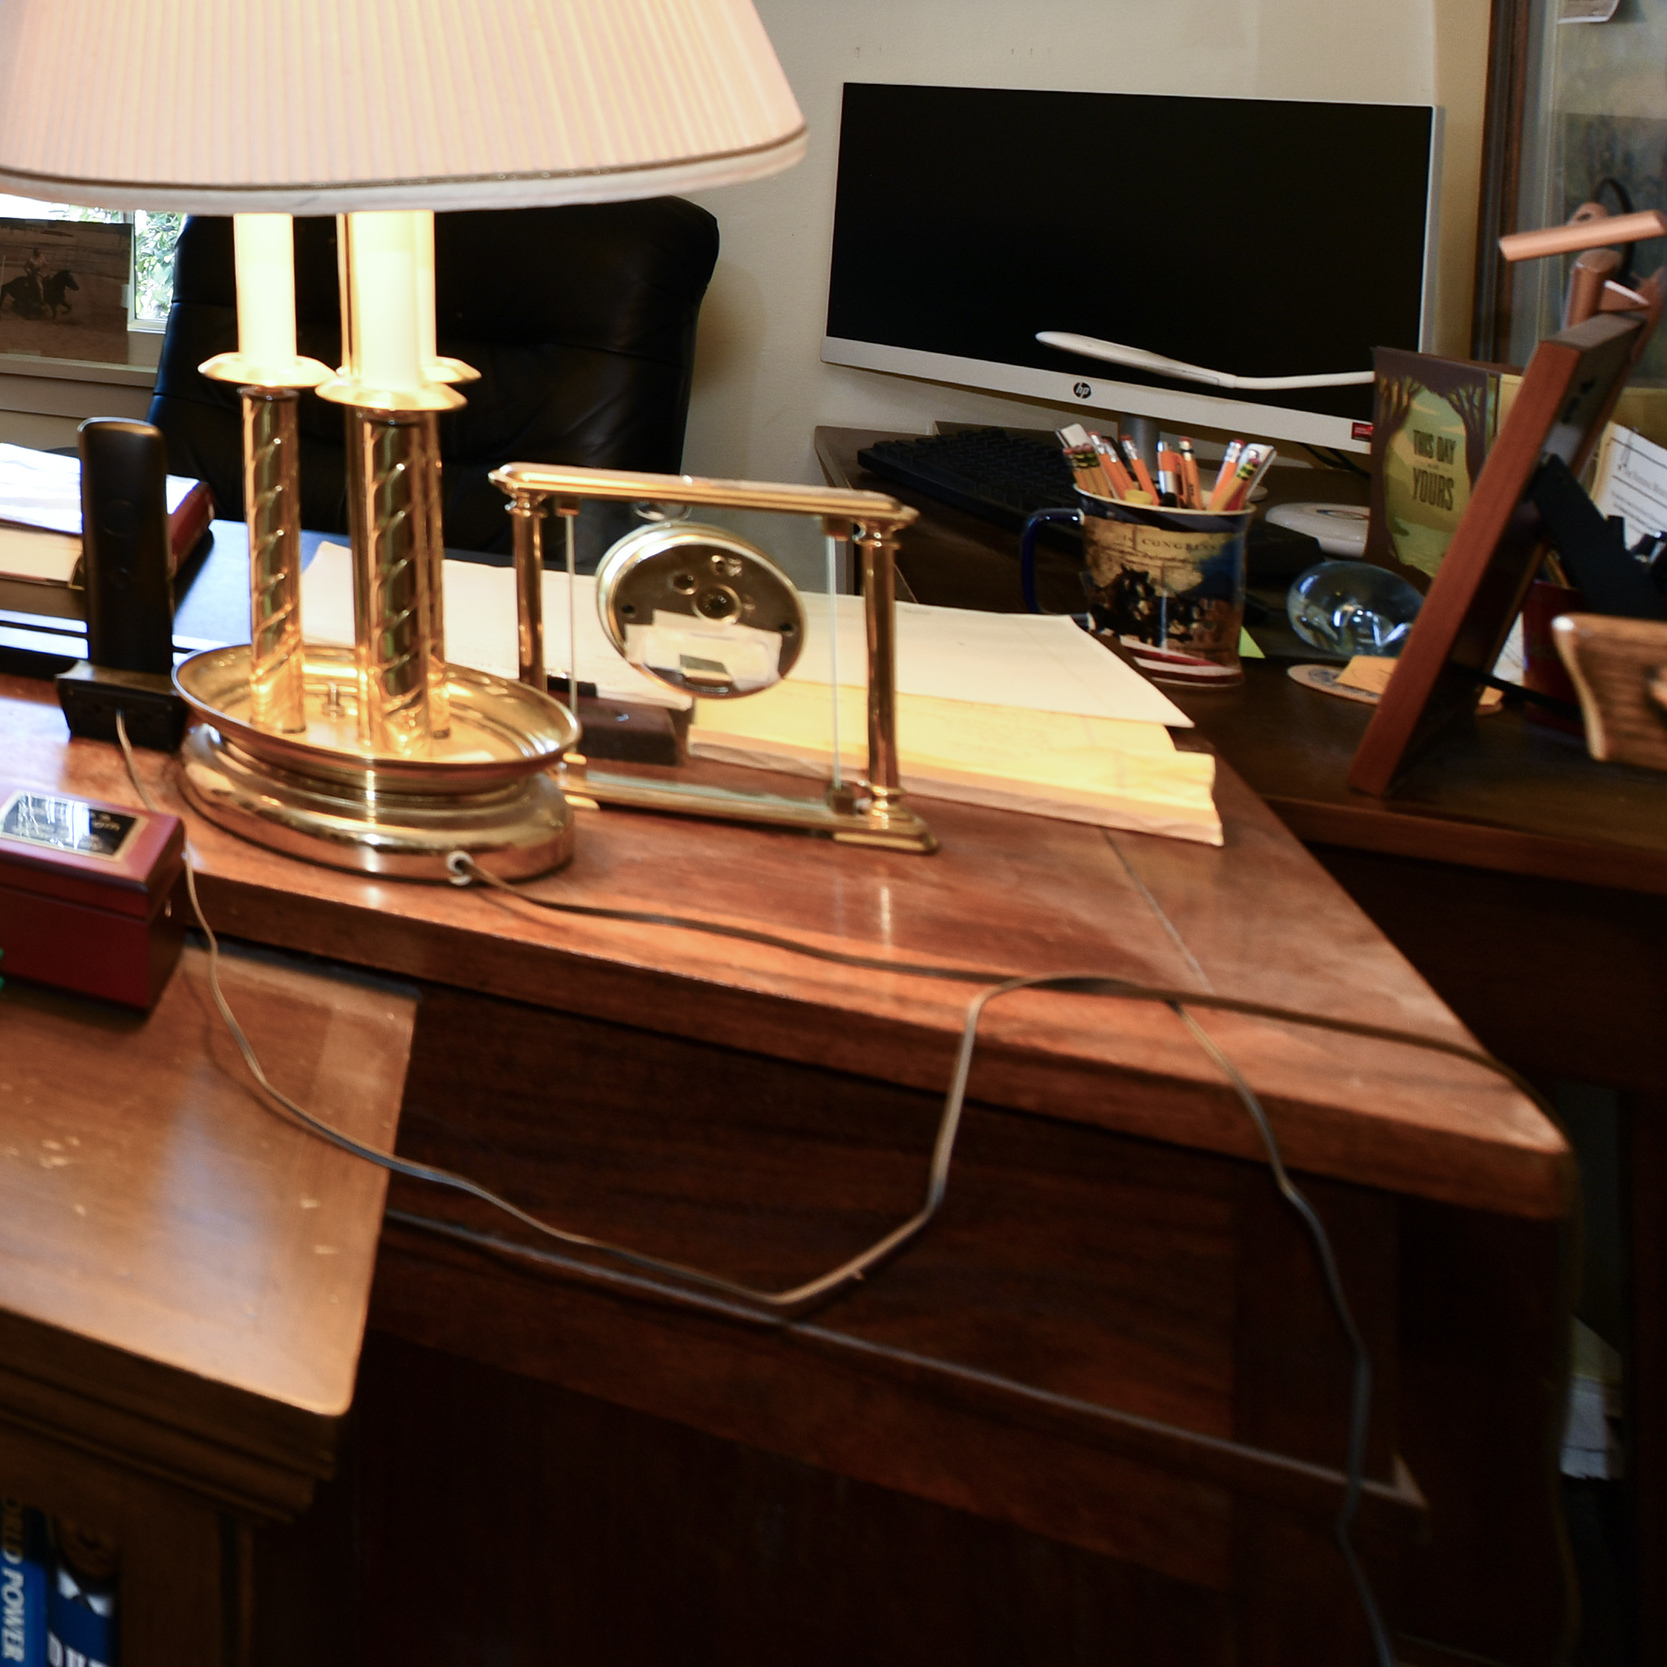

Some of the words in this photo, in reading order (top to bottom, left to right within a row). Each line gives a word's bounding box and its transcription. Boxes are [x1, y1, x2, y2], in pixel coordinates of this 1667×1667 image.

[1075, 382, 1090, 399] hp
[1412, 429, 1434, 459] THIS
[1436, 435, 1456, 465] DAY
[1412, 467, 1455, 511] YOURS
[1, 1497, 23, 1565] ORLD
[1, 1567, 25, 1664] POWER
